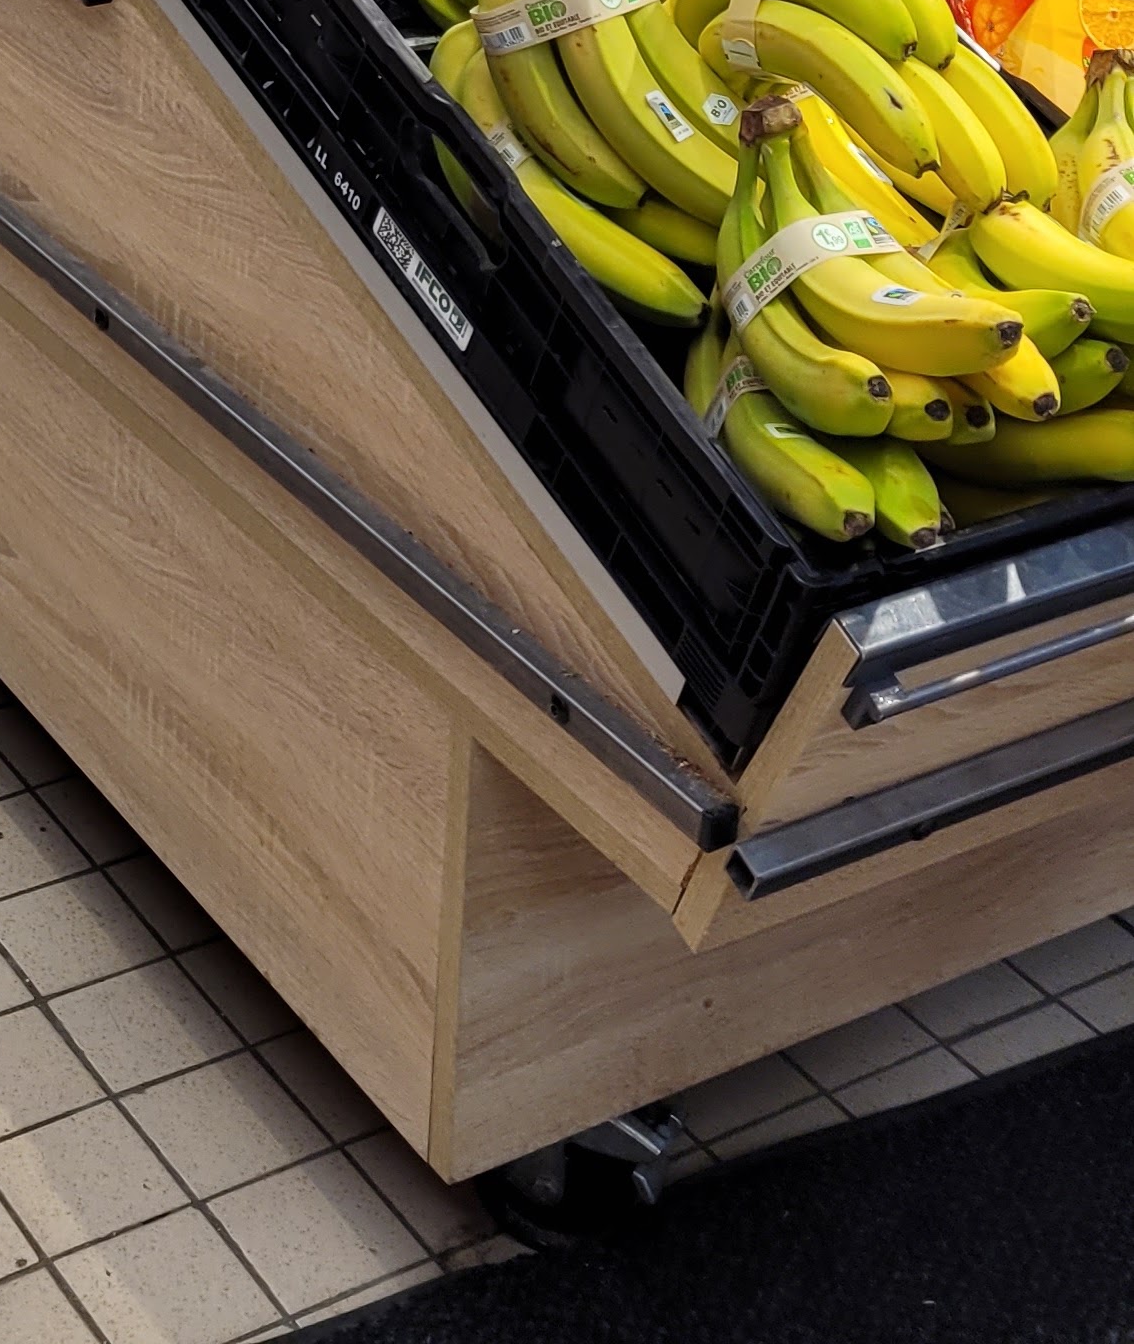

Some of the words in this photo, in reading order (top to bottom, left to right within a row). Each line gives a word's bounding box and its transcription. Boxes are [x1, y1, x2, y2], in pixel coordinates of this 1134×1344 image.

[528, 0, 567, 27] BIO
[315, 145, 327, 170] LL
[334, 171, 361, 210] 6410
[744, 248, 775, 279] Carrefour
[747, 256, 782, 294] BIO
[414, 260, 451, 314] IFCO
